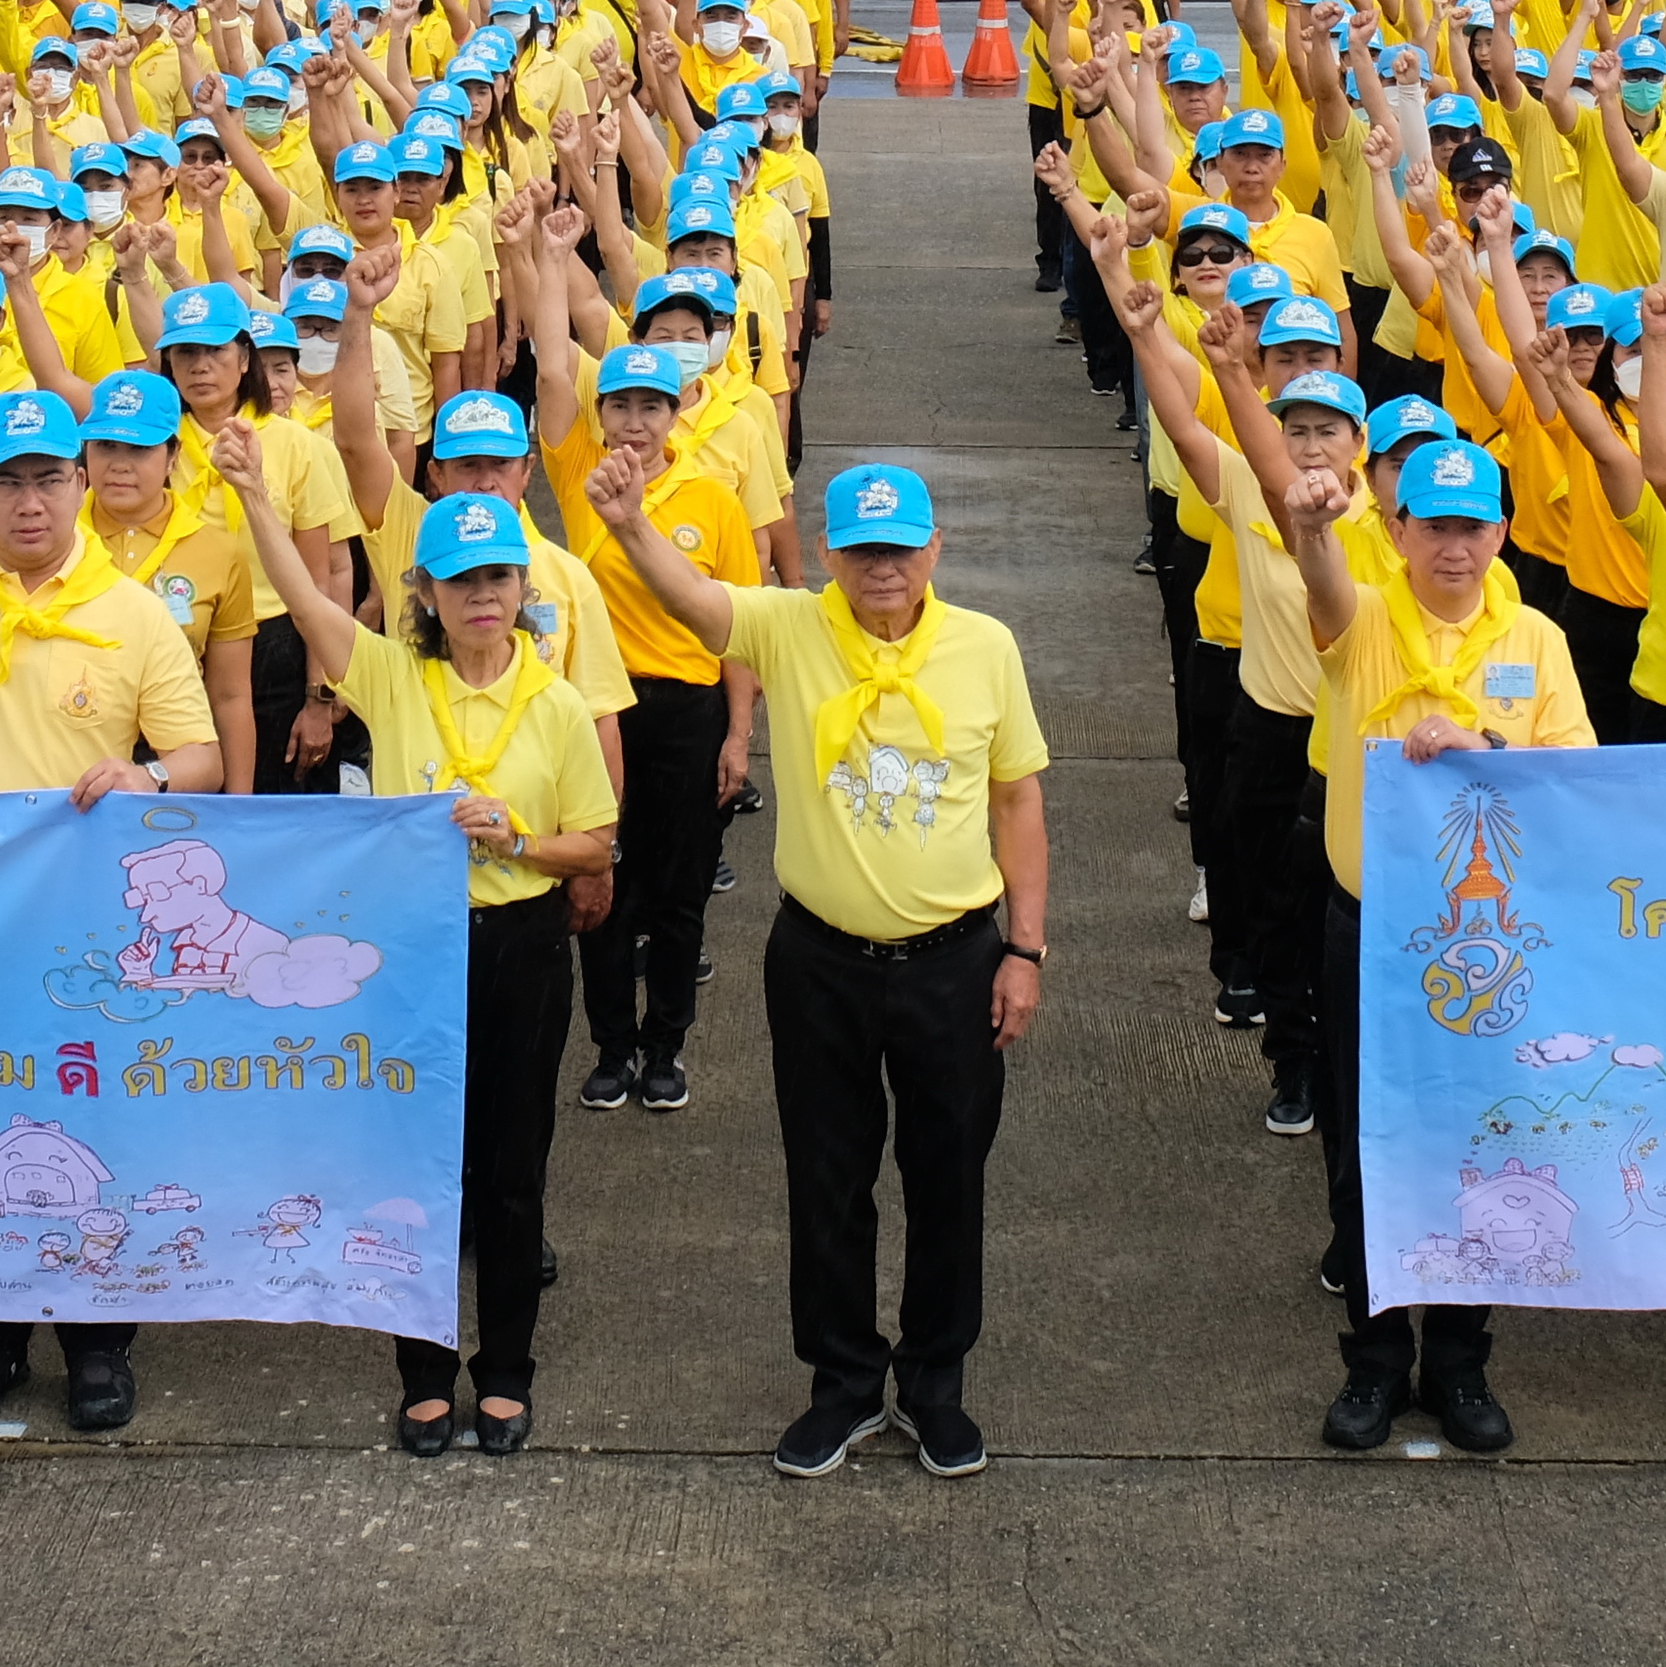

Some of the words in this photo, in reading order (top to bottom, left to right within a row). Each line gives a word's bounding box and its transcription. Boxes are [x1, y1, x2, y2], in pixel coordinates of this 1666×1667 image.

[55, 1041, 101, 1098] ดี
[122, 1032, 417, 1098] ด้วยหัวใจ
